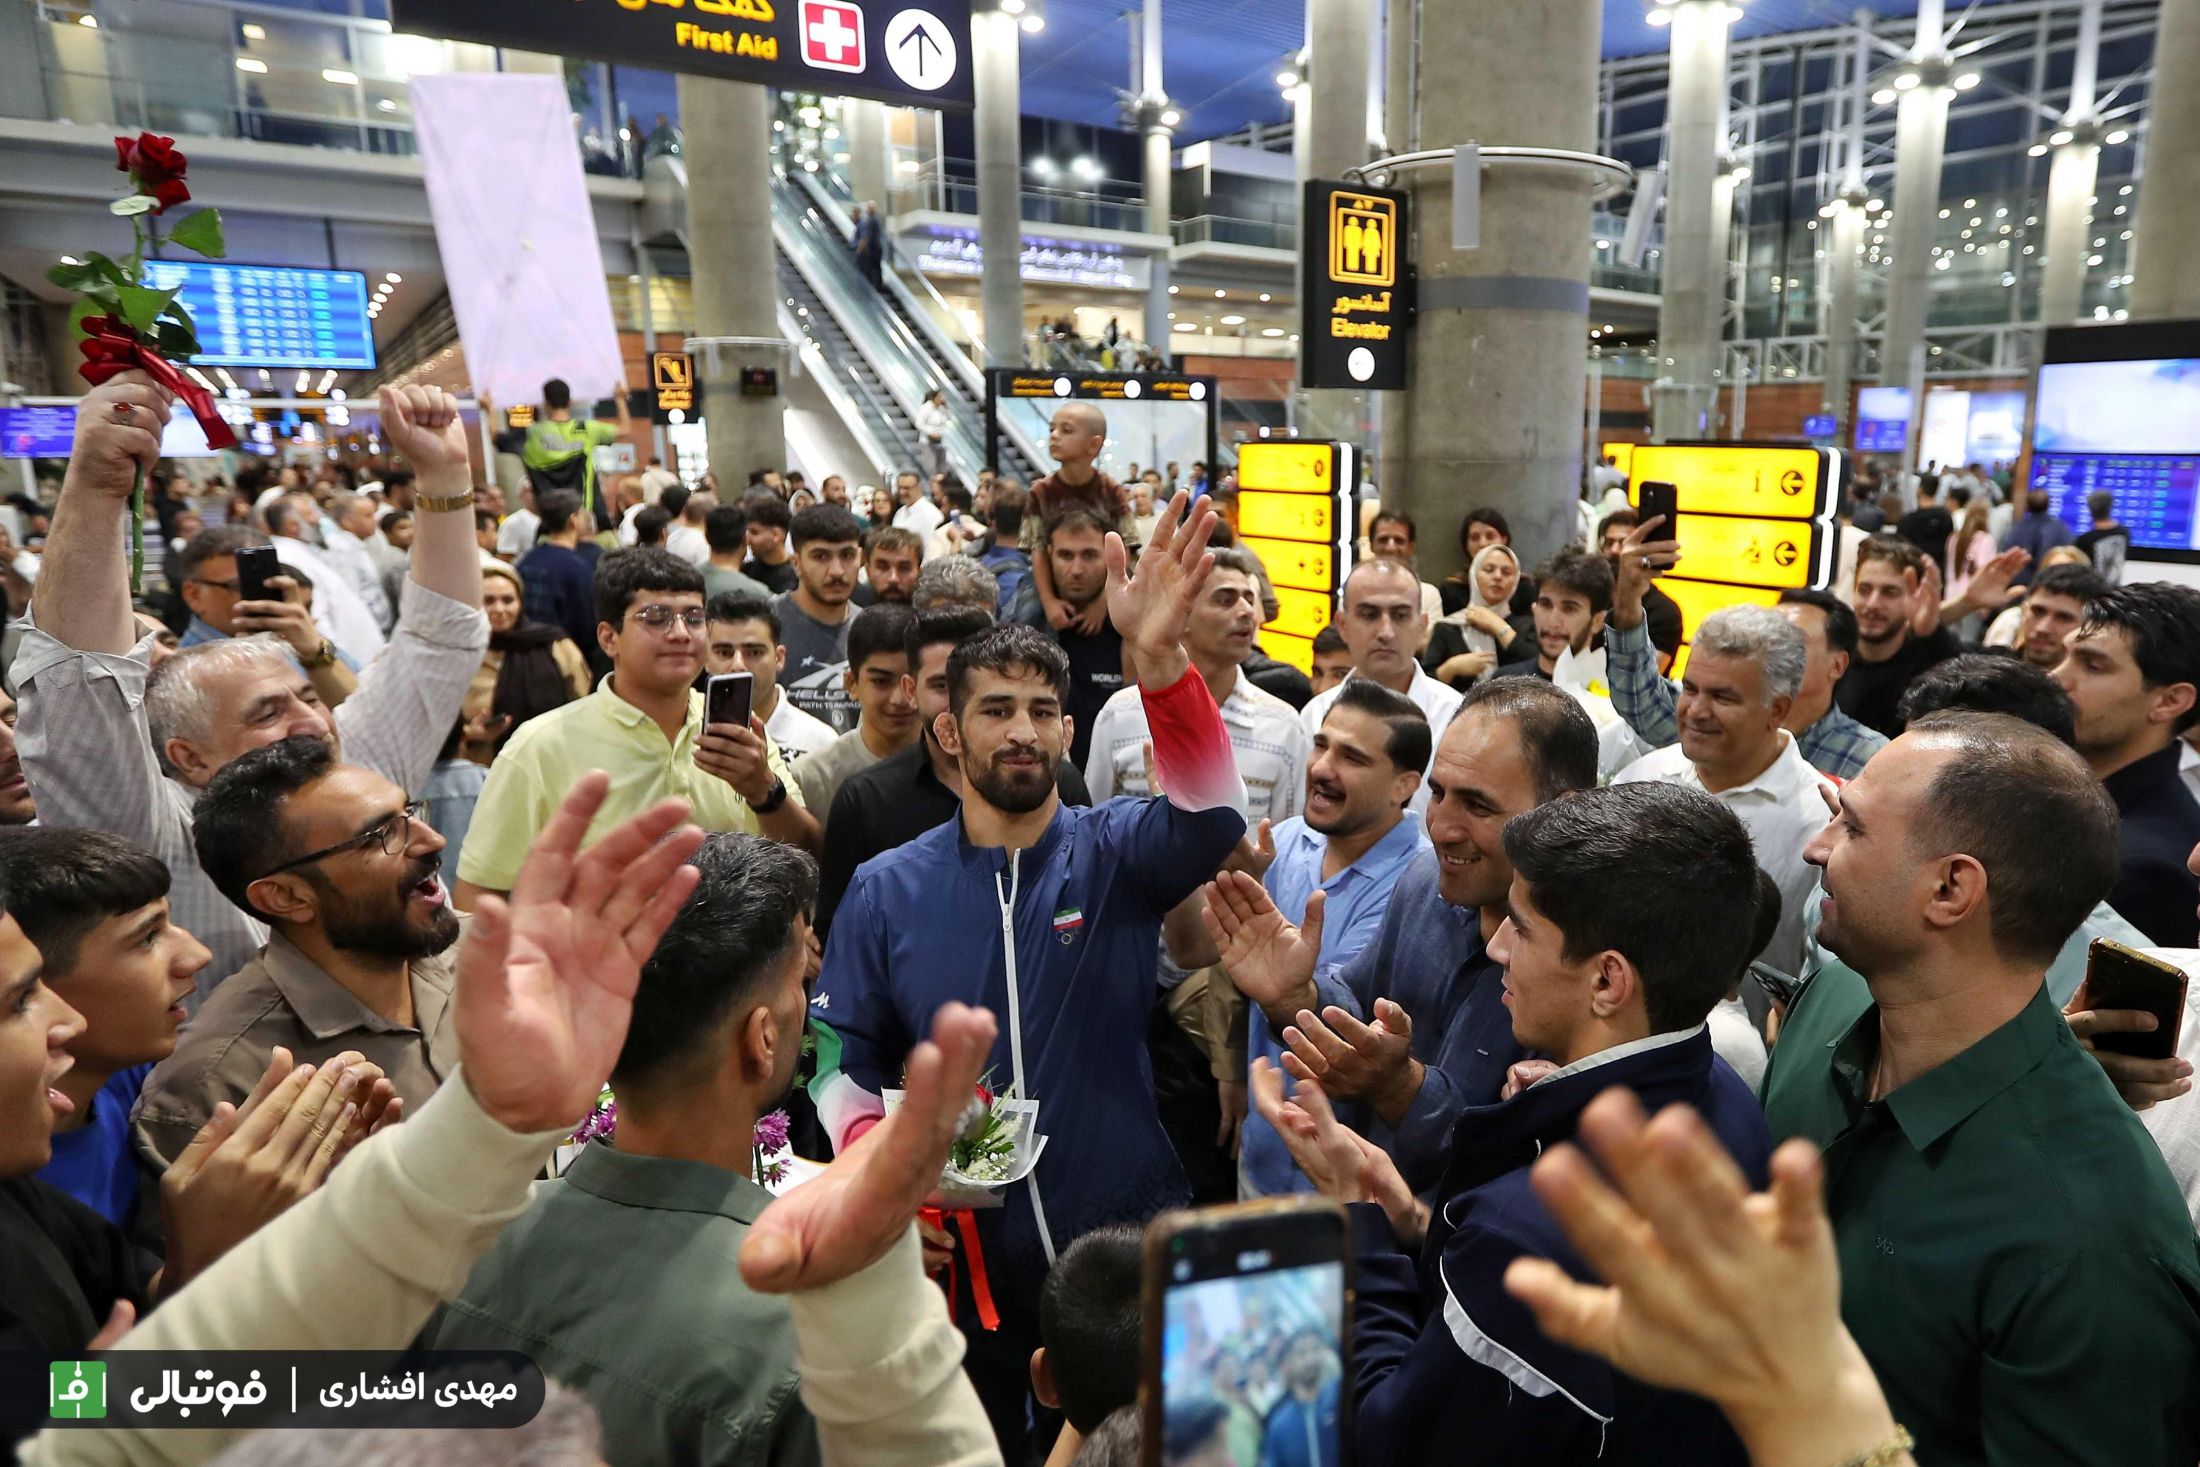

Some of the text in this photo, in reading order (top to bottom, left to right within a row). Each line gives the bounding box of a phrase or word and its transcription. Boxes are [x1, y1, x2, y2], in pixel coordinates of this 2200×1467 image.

[675, 21, 778, 61] First Aid
[1331, 291, 1392, 315] آسانسور
[1331, 317, 1392, 340] Elevator
